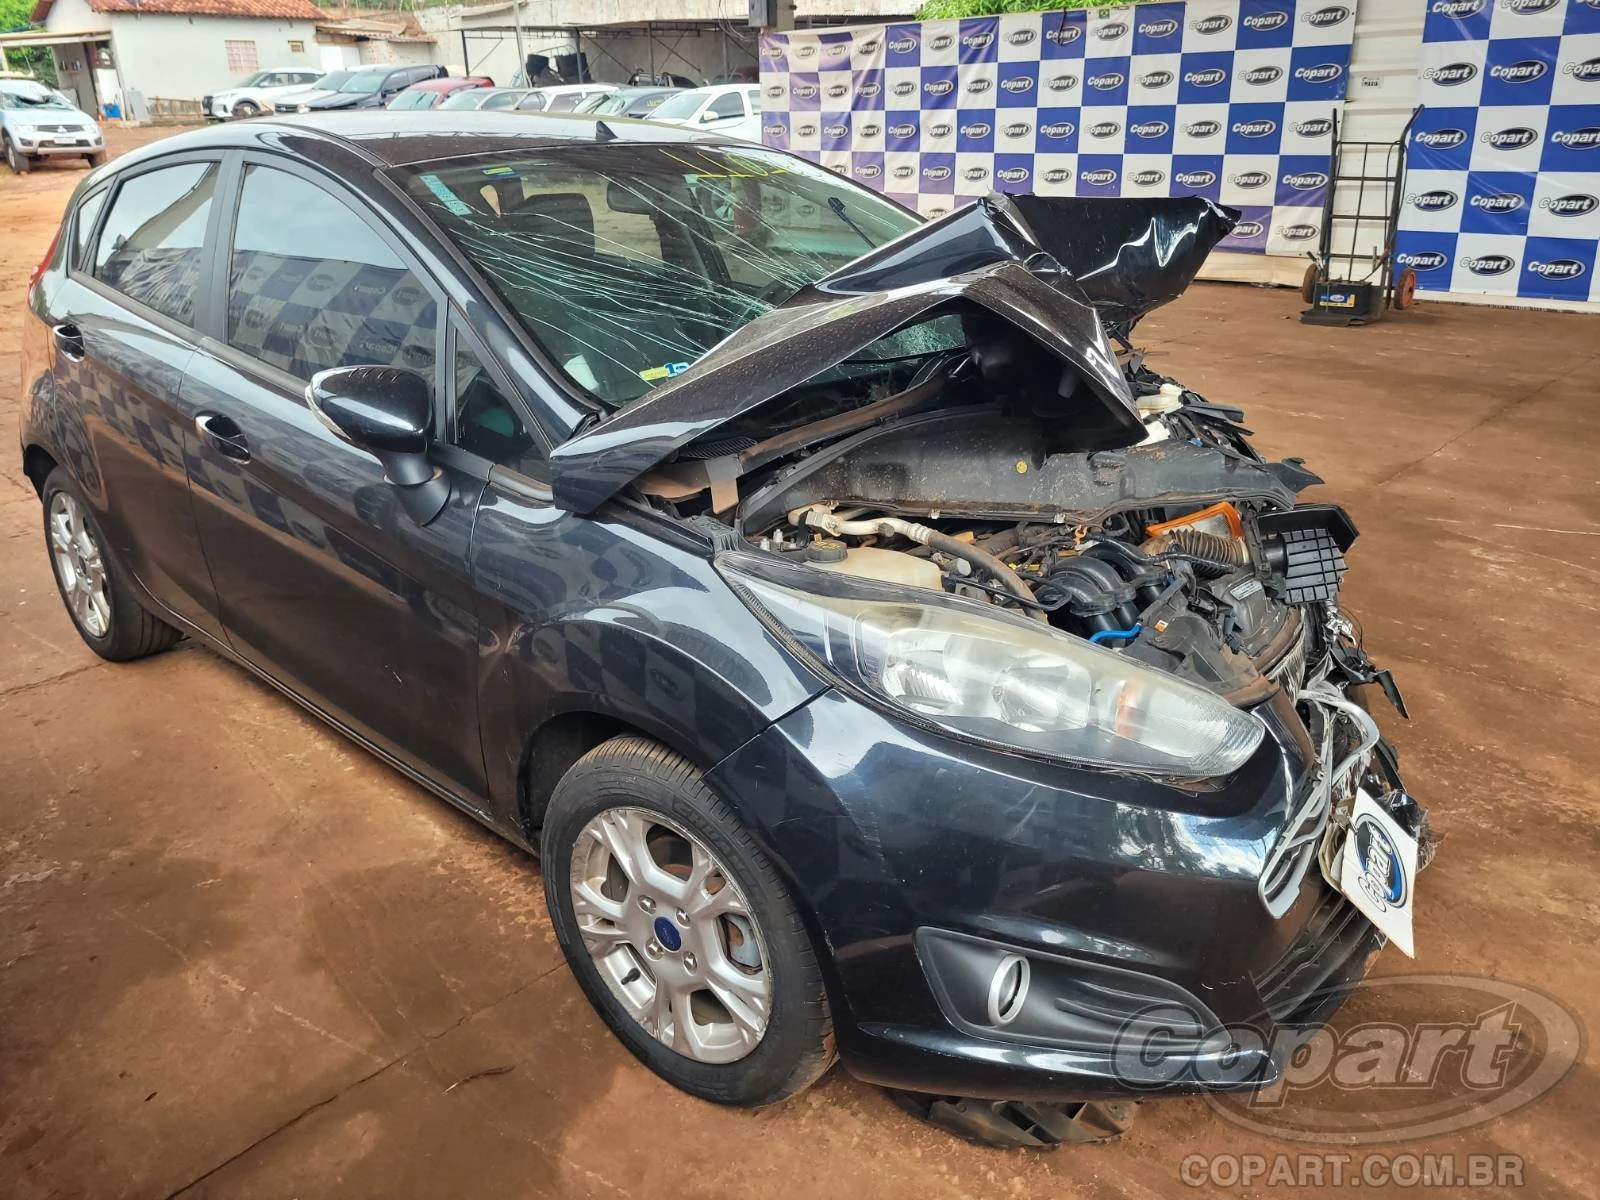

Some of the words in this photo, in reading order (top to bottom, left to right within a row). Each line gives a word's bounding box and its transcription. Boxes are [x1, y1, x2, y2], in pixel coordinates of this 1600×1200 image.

[1432, 1, 1480, 15] Copart
[1243, 15, 1282, 28] Copart
[1303, 10, 1342, 25] Copart
[1138, 22, 1173, 34] Copart
[889, 40, 912, 49] Copart
[963, 35, 990, 46] Copart
[1184, 70, 1220, 83] Copart
[1239, 69, 1277, 82] Copart
[1295, 66, 1337, 79] Copart
[1423, 66, 1469, 81] Copart
[1490, 63, 1541, 79] Copart
[924, 82, 950, 93] Copart
[1001, 78, 1030, 89] Copart
[1088, 75, 1119, 87] Copart
[824, 126, 844, 136] Copart
[888, 125, 912, 136] Copart
[960, 125, 986, 136] Copart
[1040, 124, 1070, 135] Copart
[1130, 123, 1165, 135] Copart
[1232, 122, 1270, 134] Copart
[1289, 121, 1329, 134] Copart
[1415, 131, 1461, 146] Copart
[1480, 130, 1529, 146] Copart
[922, 168, 948, 178] Copart
[997, 169, 1025, 180] Copart
[1081, 171, 1112, 182] Copart
[1175, 172, 1212, 184] Copart
[1282, 174, 1323, 187] Copart
[1407, 193, 1451, 208] Copart
[1470, 194, 1519, 210] Copart
[1539, 198, 1592, 213] Copart
[1232, 225, 1258, 235] part
[1397, 253, 1442, 267] Copart
[1459, 257, 1509, 272] Copart
[1528, 260, 1579, 276] Copart
[1358, 822, 1394, 912] Copart
